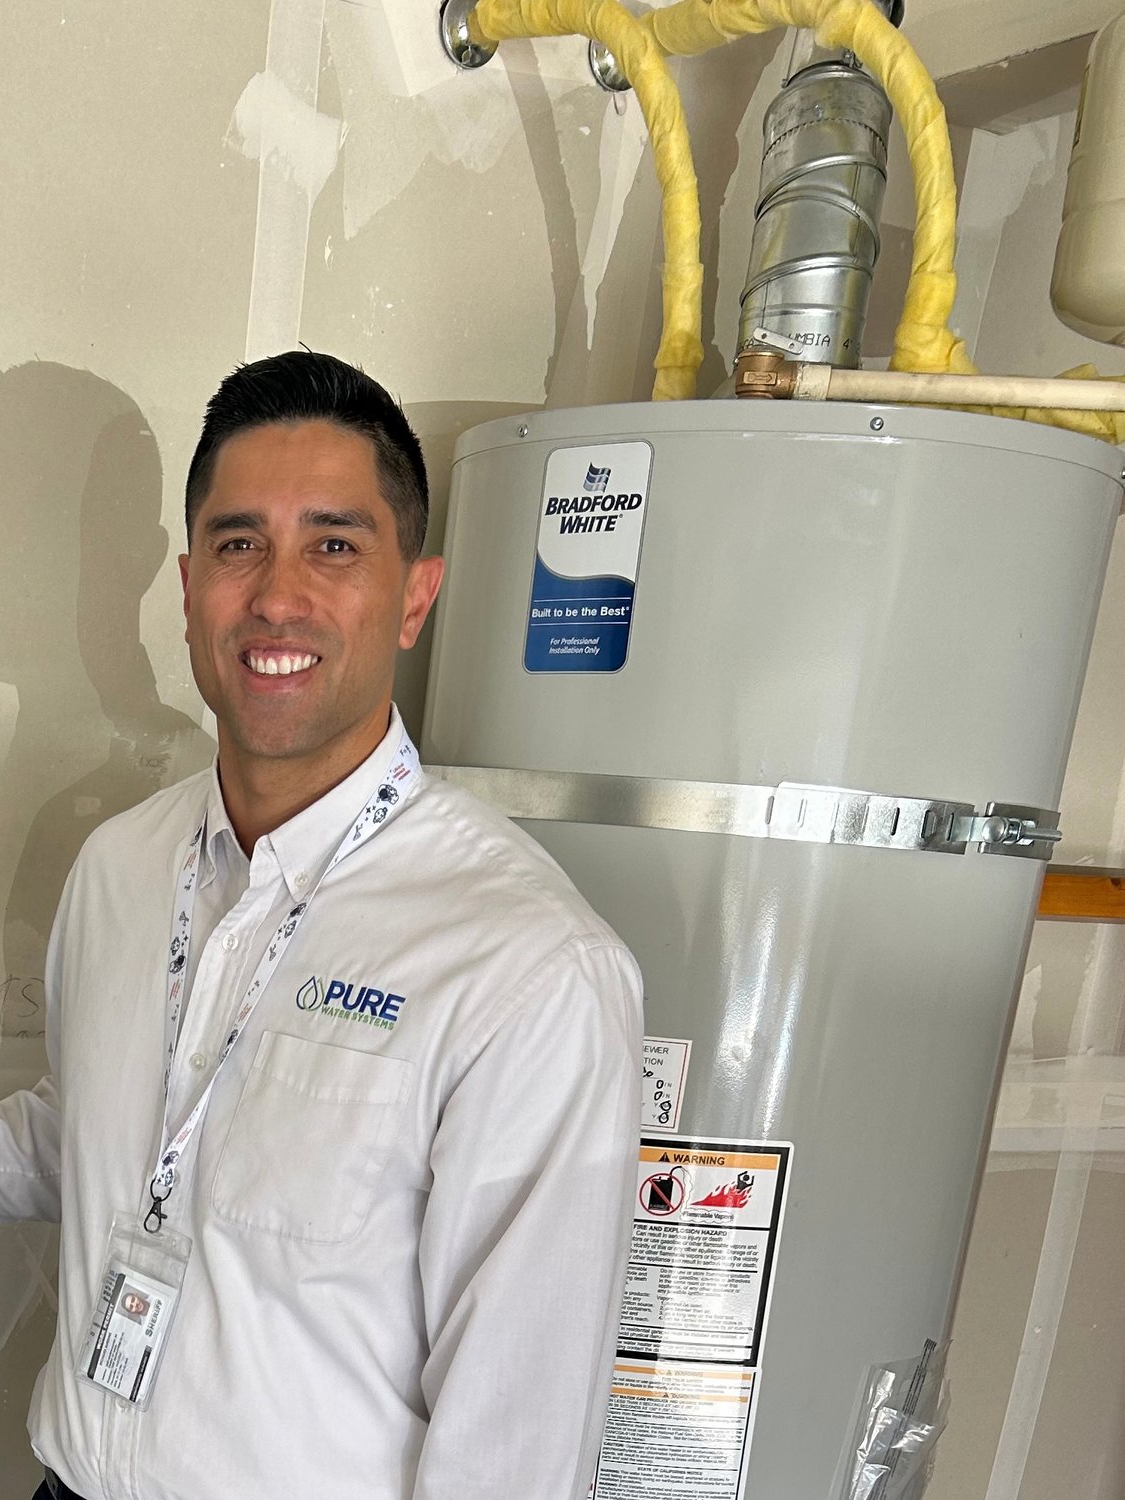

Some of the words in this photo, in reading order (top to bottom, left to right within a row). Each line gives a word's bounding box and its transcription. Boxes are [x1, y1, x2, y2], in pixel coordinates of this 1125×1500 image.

[545, 493, 642, 516] BRADFORD
[559, 514, 617, 534] WHITE
[531, 608, 551, 618] Built
[553, 608, 562, 617] to
[565, 607, 578, 617] be
[581, 607, 597, 616] the
[600, 606, 625, 616] Best
[561, 637, 599, 645] Professional
[549, 646, 583, 654] Installation
[584, 646, 600, 655] Only
[323, 980, 406, 1022] PURE
[321, 1006, 349, 1020] WATER
[350, 1012, 395, 1031] SYSTEMS
[643, 1045, 669, 1054] EWER
[673, 1154, 725, 1165] WARNING
[145, 1299, 163, 1337] SHERIFF
